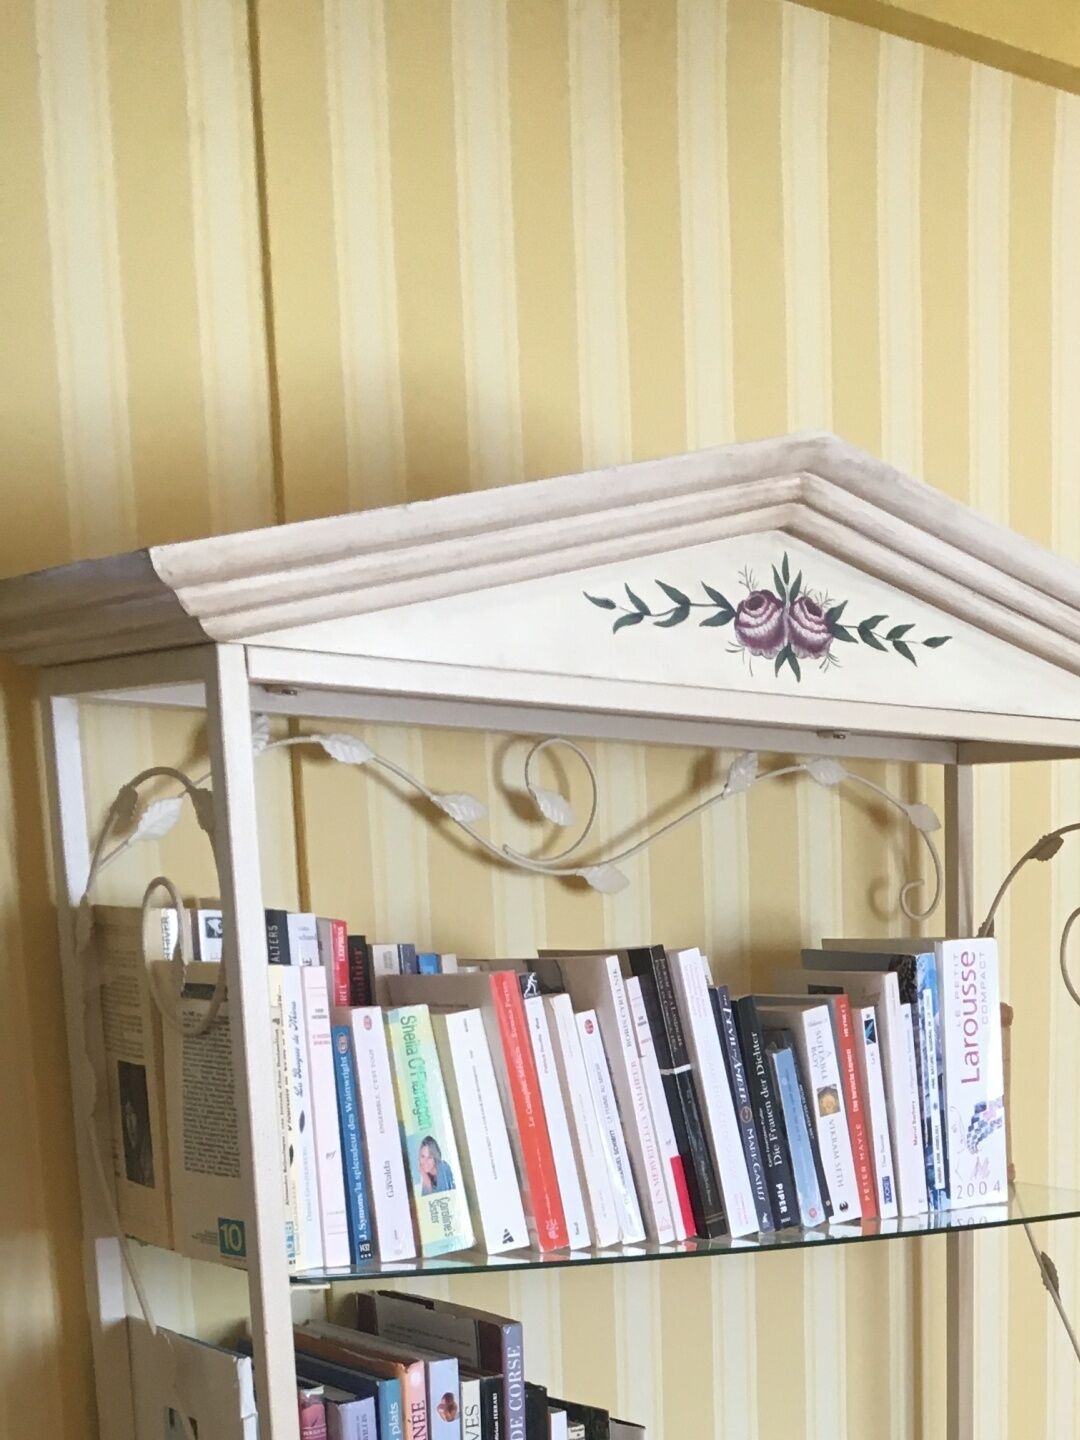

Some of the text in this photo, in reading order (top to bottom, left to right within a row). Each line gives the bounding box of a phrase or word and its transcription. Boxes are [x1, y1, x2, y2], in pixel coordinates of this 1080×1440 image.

[952, 952, 961, 1027] LE PETIT
[979, 951, 988, 1025] COMPACT
[399, 1014, 422, 1055] Sheila
[621, 1019, 633, 1047] BORIS
[959, 949, 980, 1084] Larousse
[722, 1007, 748, 1104] DEVIL AMBER
[814, 1029, 828, 1080] SUITABLE
[339, 1055, 362, 1179] splendeur des Wainwright
[749, 1031, 782, 1165] Die Frauen der Dichter
[827, 1118, 844, 1187] VIKRAM SETH
[855, 1122, 865, 1160] MAYLE
[381, 1159, 395, 1198] Gavalda
[745, 1128, 766, 1202] MARK GATISS
[860, 1164, 870, 1201] PETER
[775, 1182, 787, 1213] PIPER
[955, 1179, 1002, 1199] 2004
[427, 1199, 442, 1223] Sister
[437, 1196, 456, 1237] Caroline's
[219, 1222, 243, 1252] 10
[506, 1344, 522, 1411] CORSE
[387, 1401, 402, 1435] plats
